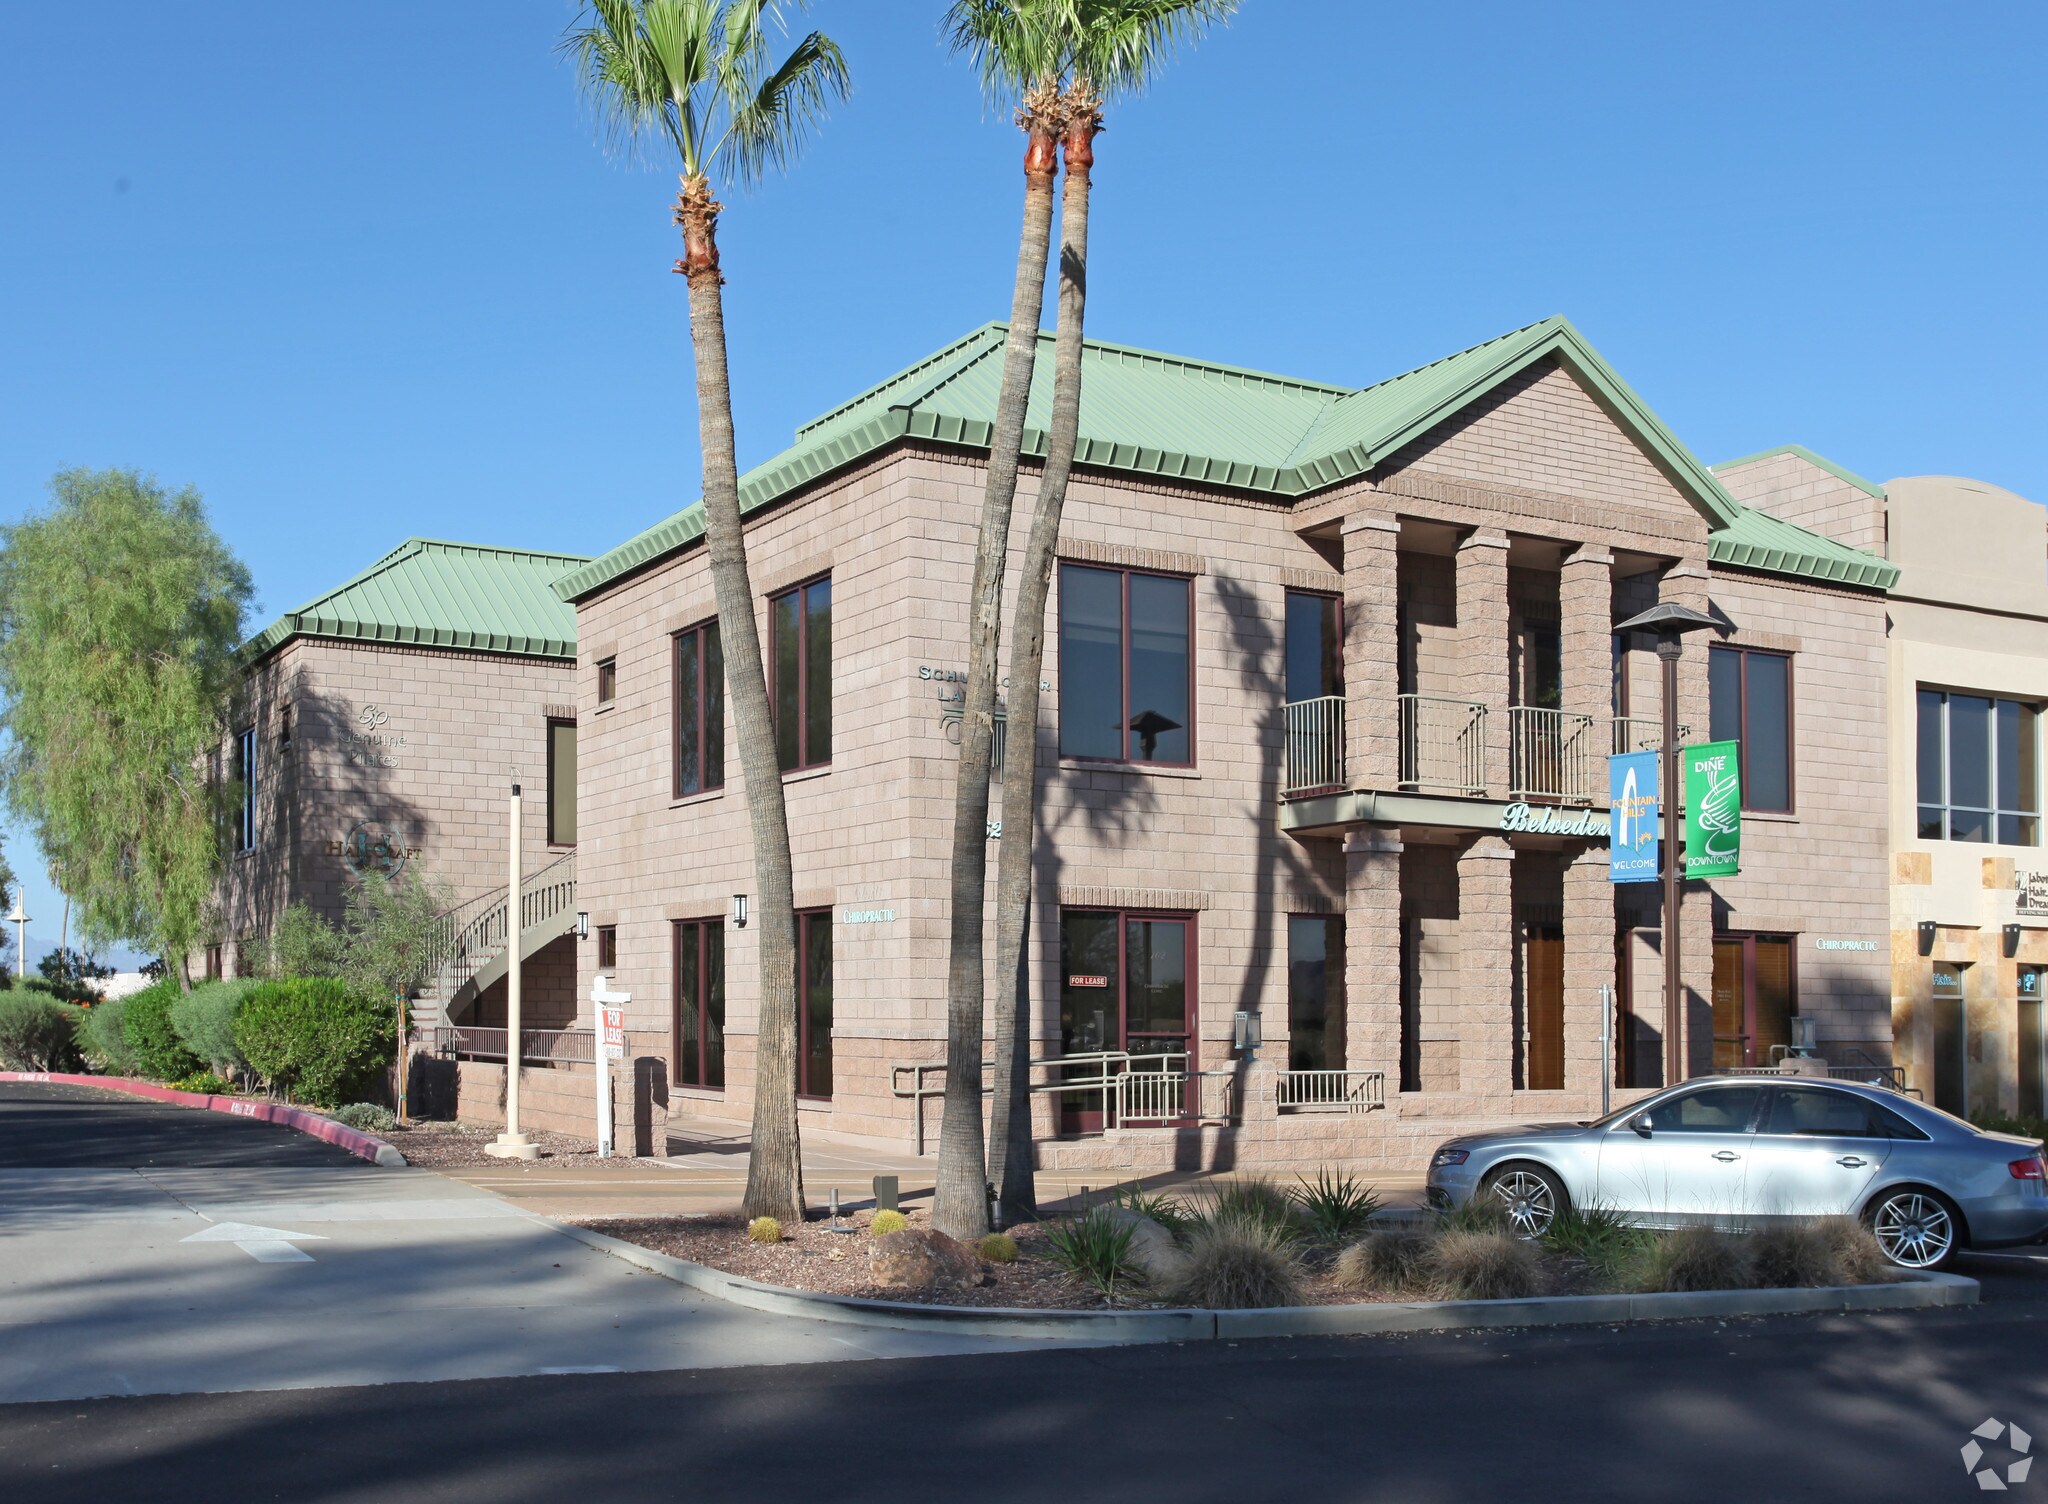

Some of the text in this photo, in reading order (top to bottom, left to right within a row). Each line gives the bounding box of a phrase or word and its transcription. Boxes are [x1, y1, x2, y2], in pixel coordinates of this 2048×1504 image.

[340, 729, 408, 747] Genuine
[350, 748, 399, 767] Pilates
[1695, 760, 1725, 773] DINE
[1612, 795, 1656, 809] FOUNTAIN
[1623, 807, 1646, 817] HILLS
[1613, 859, 1655, 870] WELCOME
[1688, 855, 1737, 867] DOWNTOWN
[1816, 937, 1878, 951] CHIROPRACTIC
[1085, 977, 1105, 985] LEASE
[608, 1010, 621, 1026] FOR
[606, 1027, 622, 1044] LEASE
